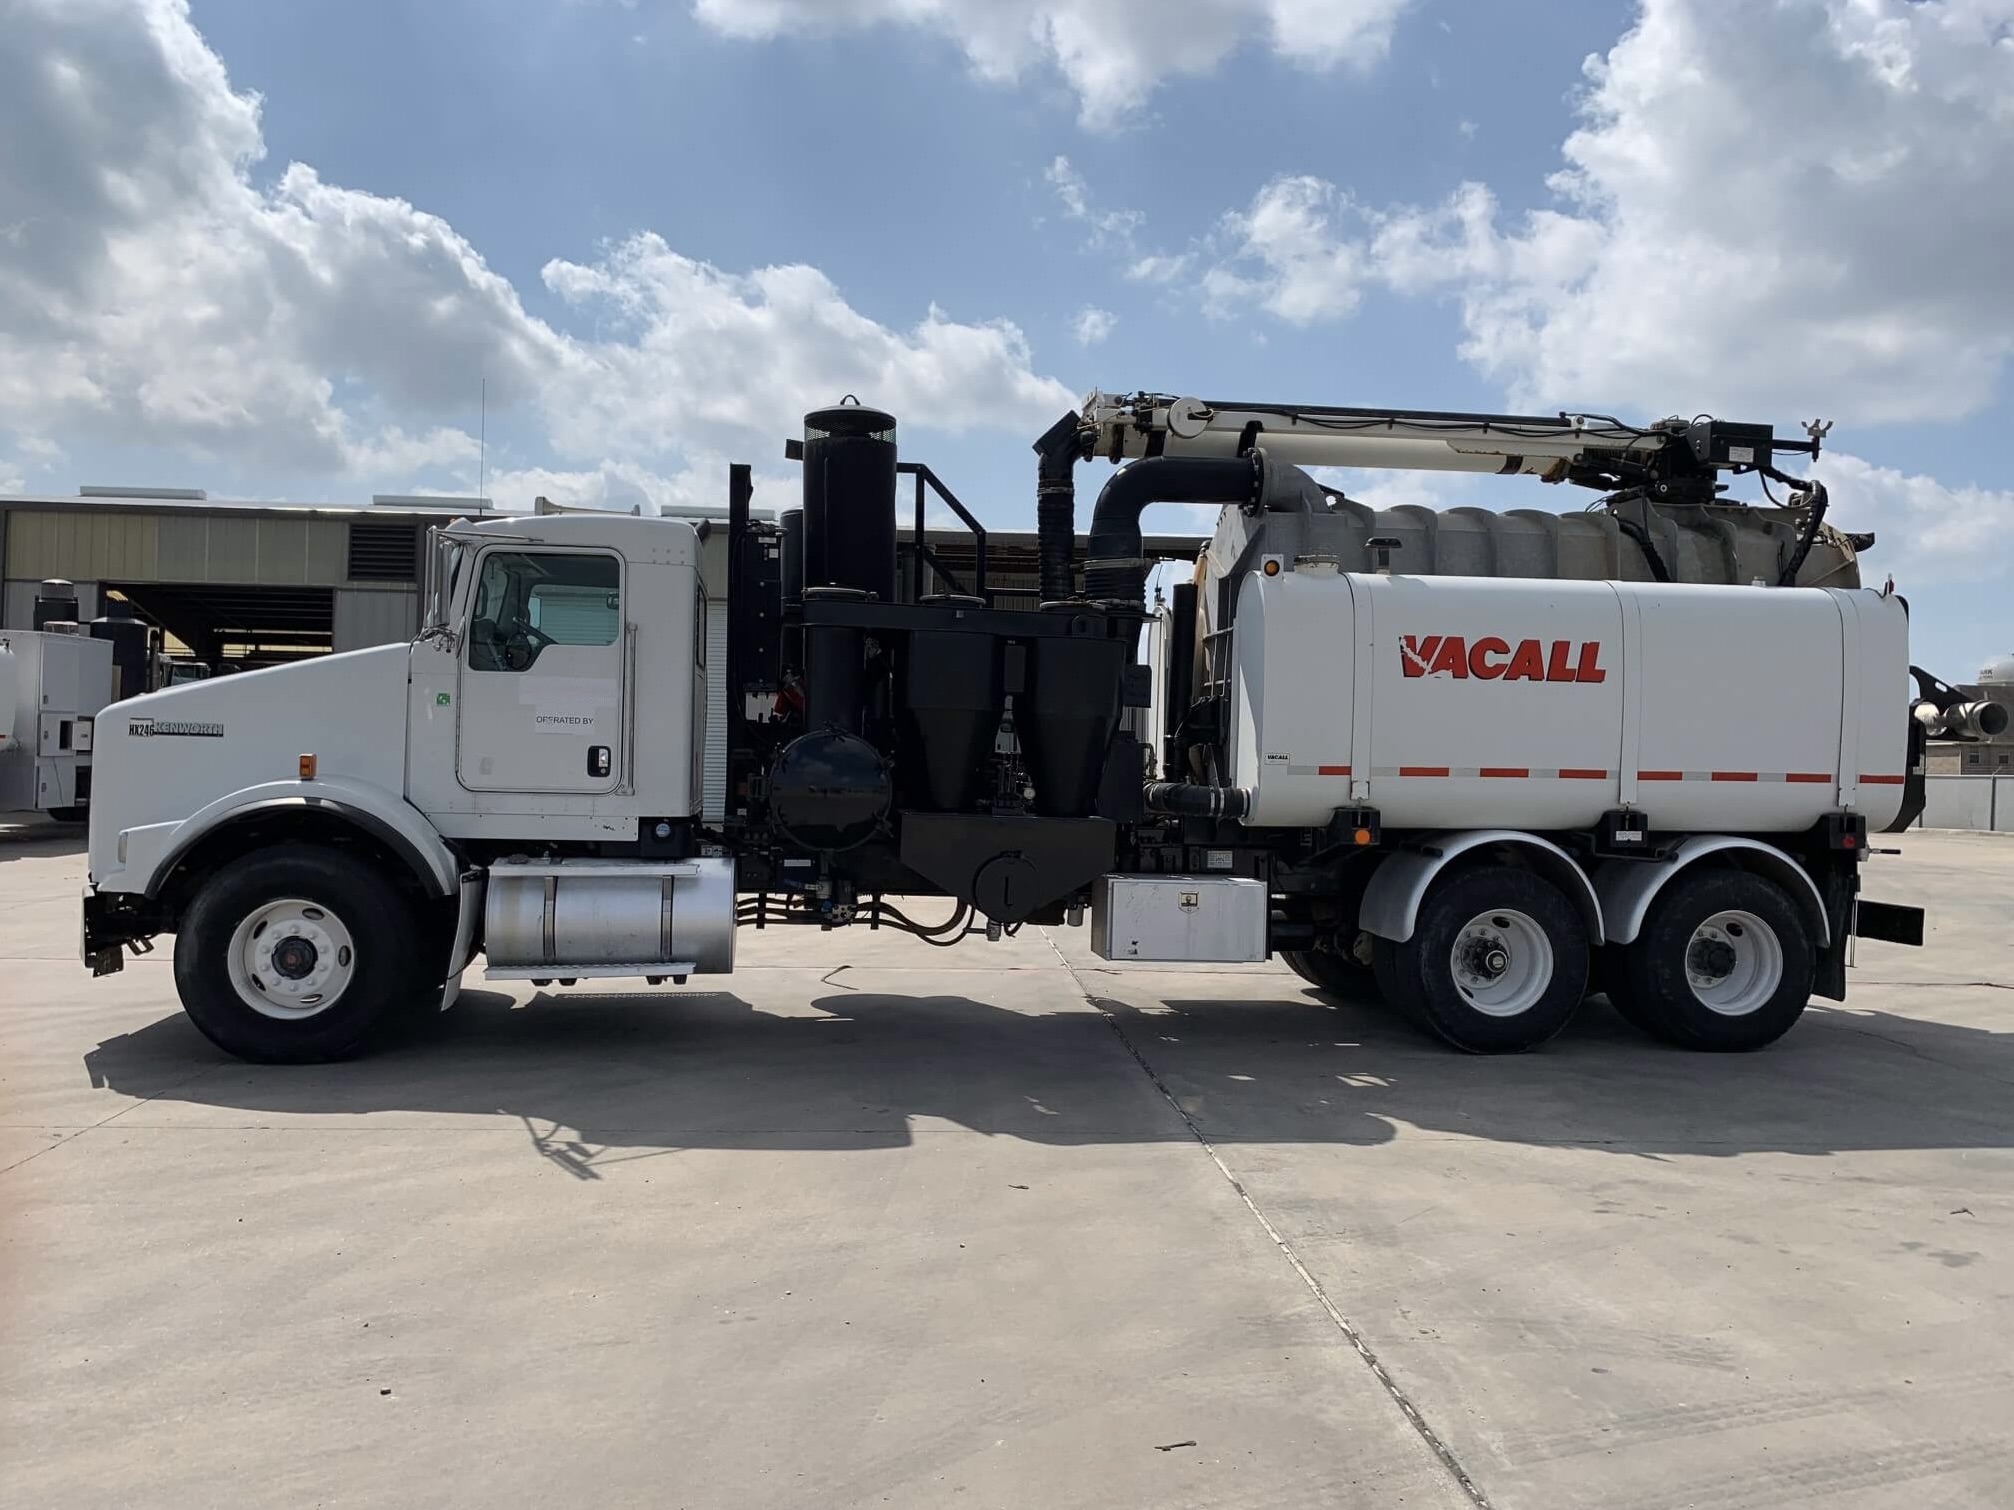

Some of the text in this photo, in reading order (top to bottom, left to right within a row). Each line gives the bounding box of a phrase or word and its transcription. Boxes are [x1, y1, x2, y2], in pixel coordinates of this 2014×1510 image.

[1399, 634, 1606, 683] VACALL
[582, 717, 594, 725] BY
[155, 722, 223, 735] KENWORTH
